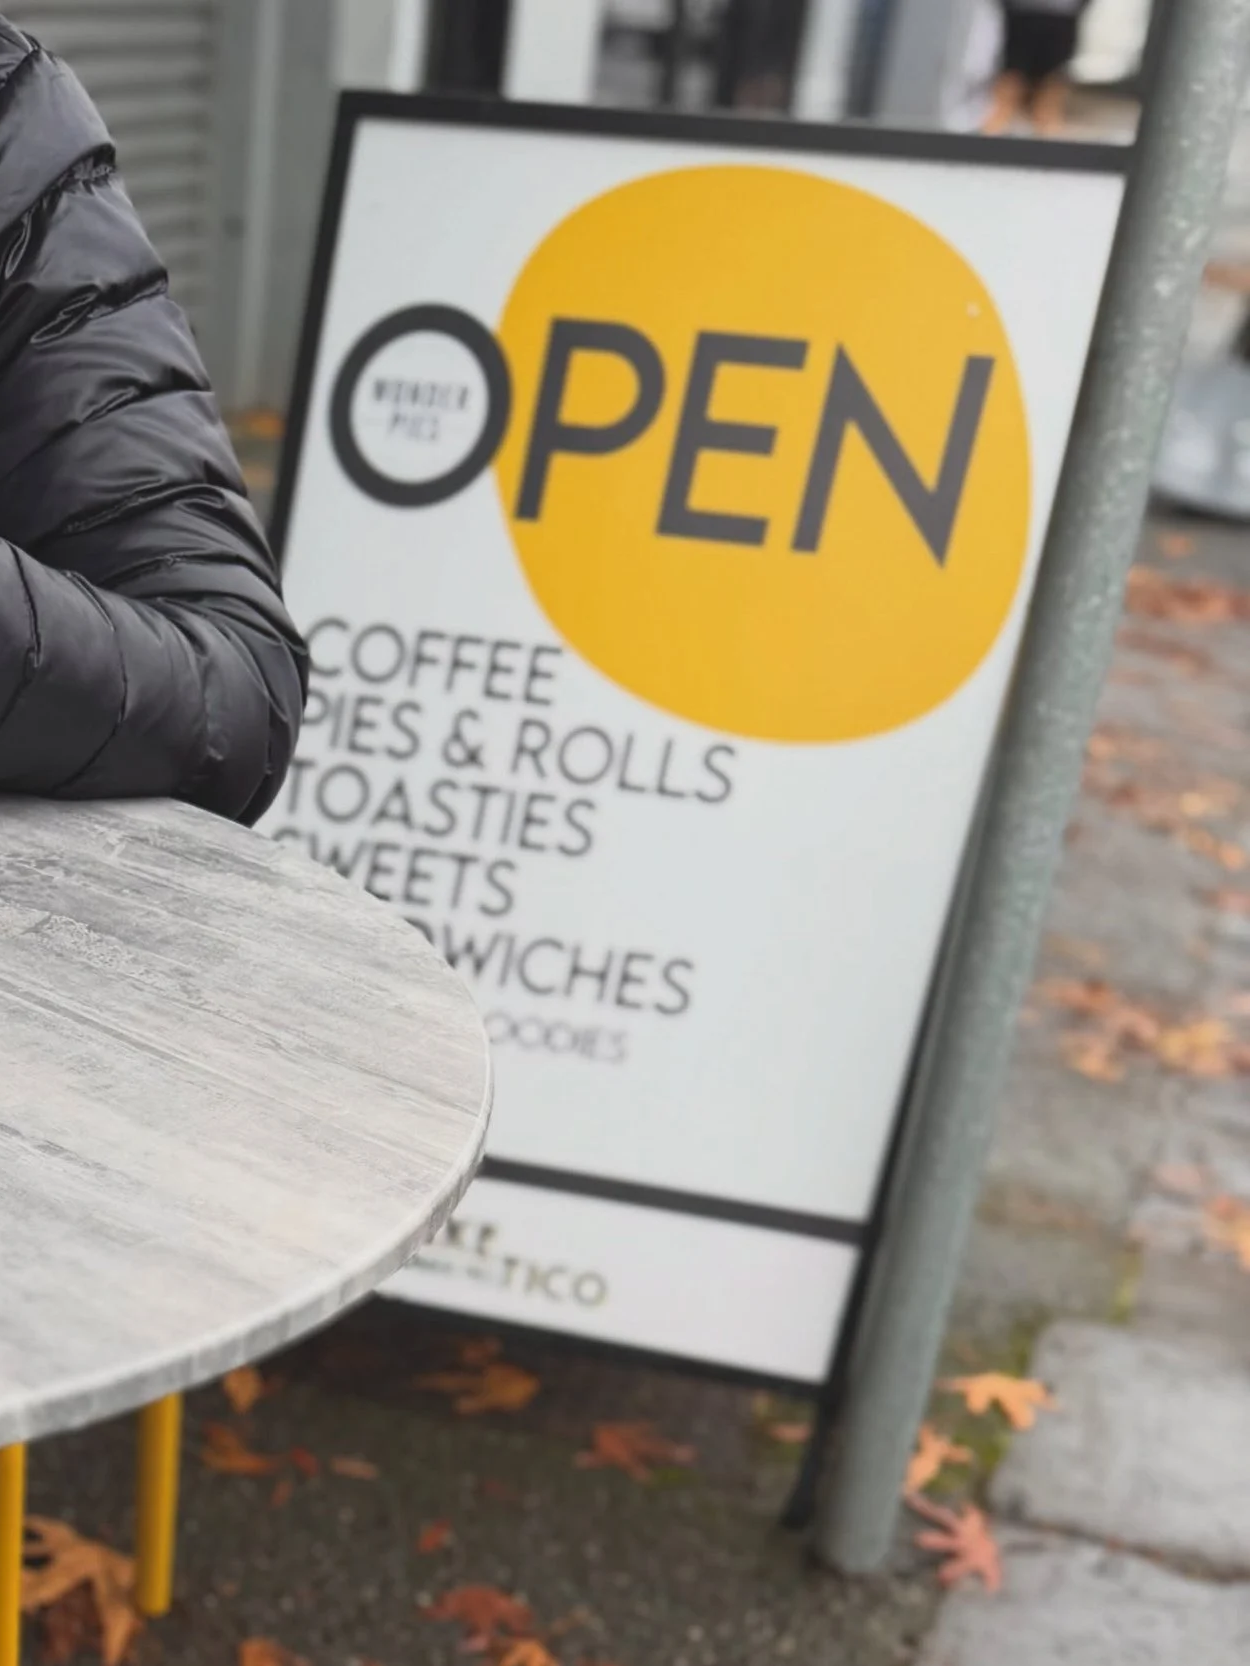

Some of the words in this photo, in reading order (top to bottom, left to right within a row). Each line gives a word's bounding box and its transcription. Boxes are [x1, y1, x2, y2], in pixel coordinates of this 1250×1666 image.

[328, 302, 996, 569] OPEN
[305, 617, 563, 707] COFFEE
[440, 708, 486, 771] &
[511, 717, 739, 804] ROLLS
[288, 757, 598, 858] TOASTIES
[402, 916, 695, 1016] WICHES
